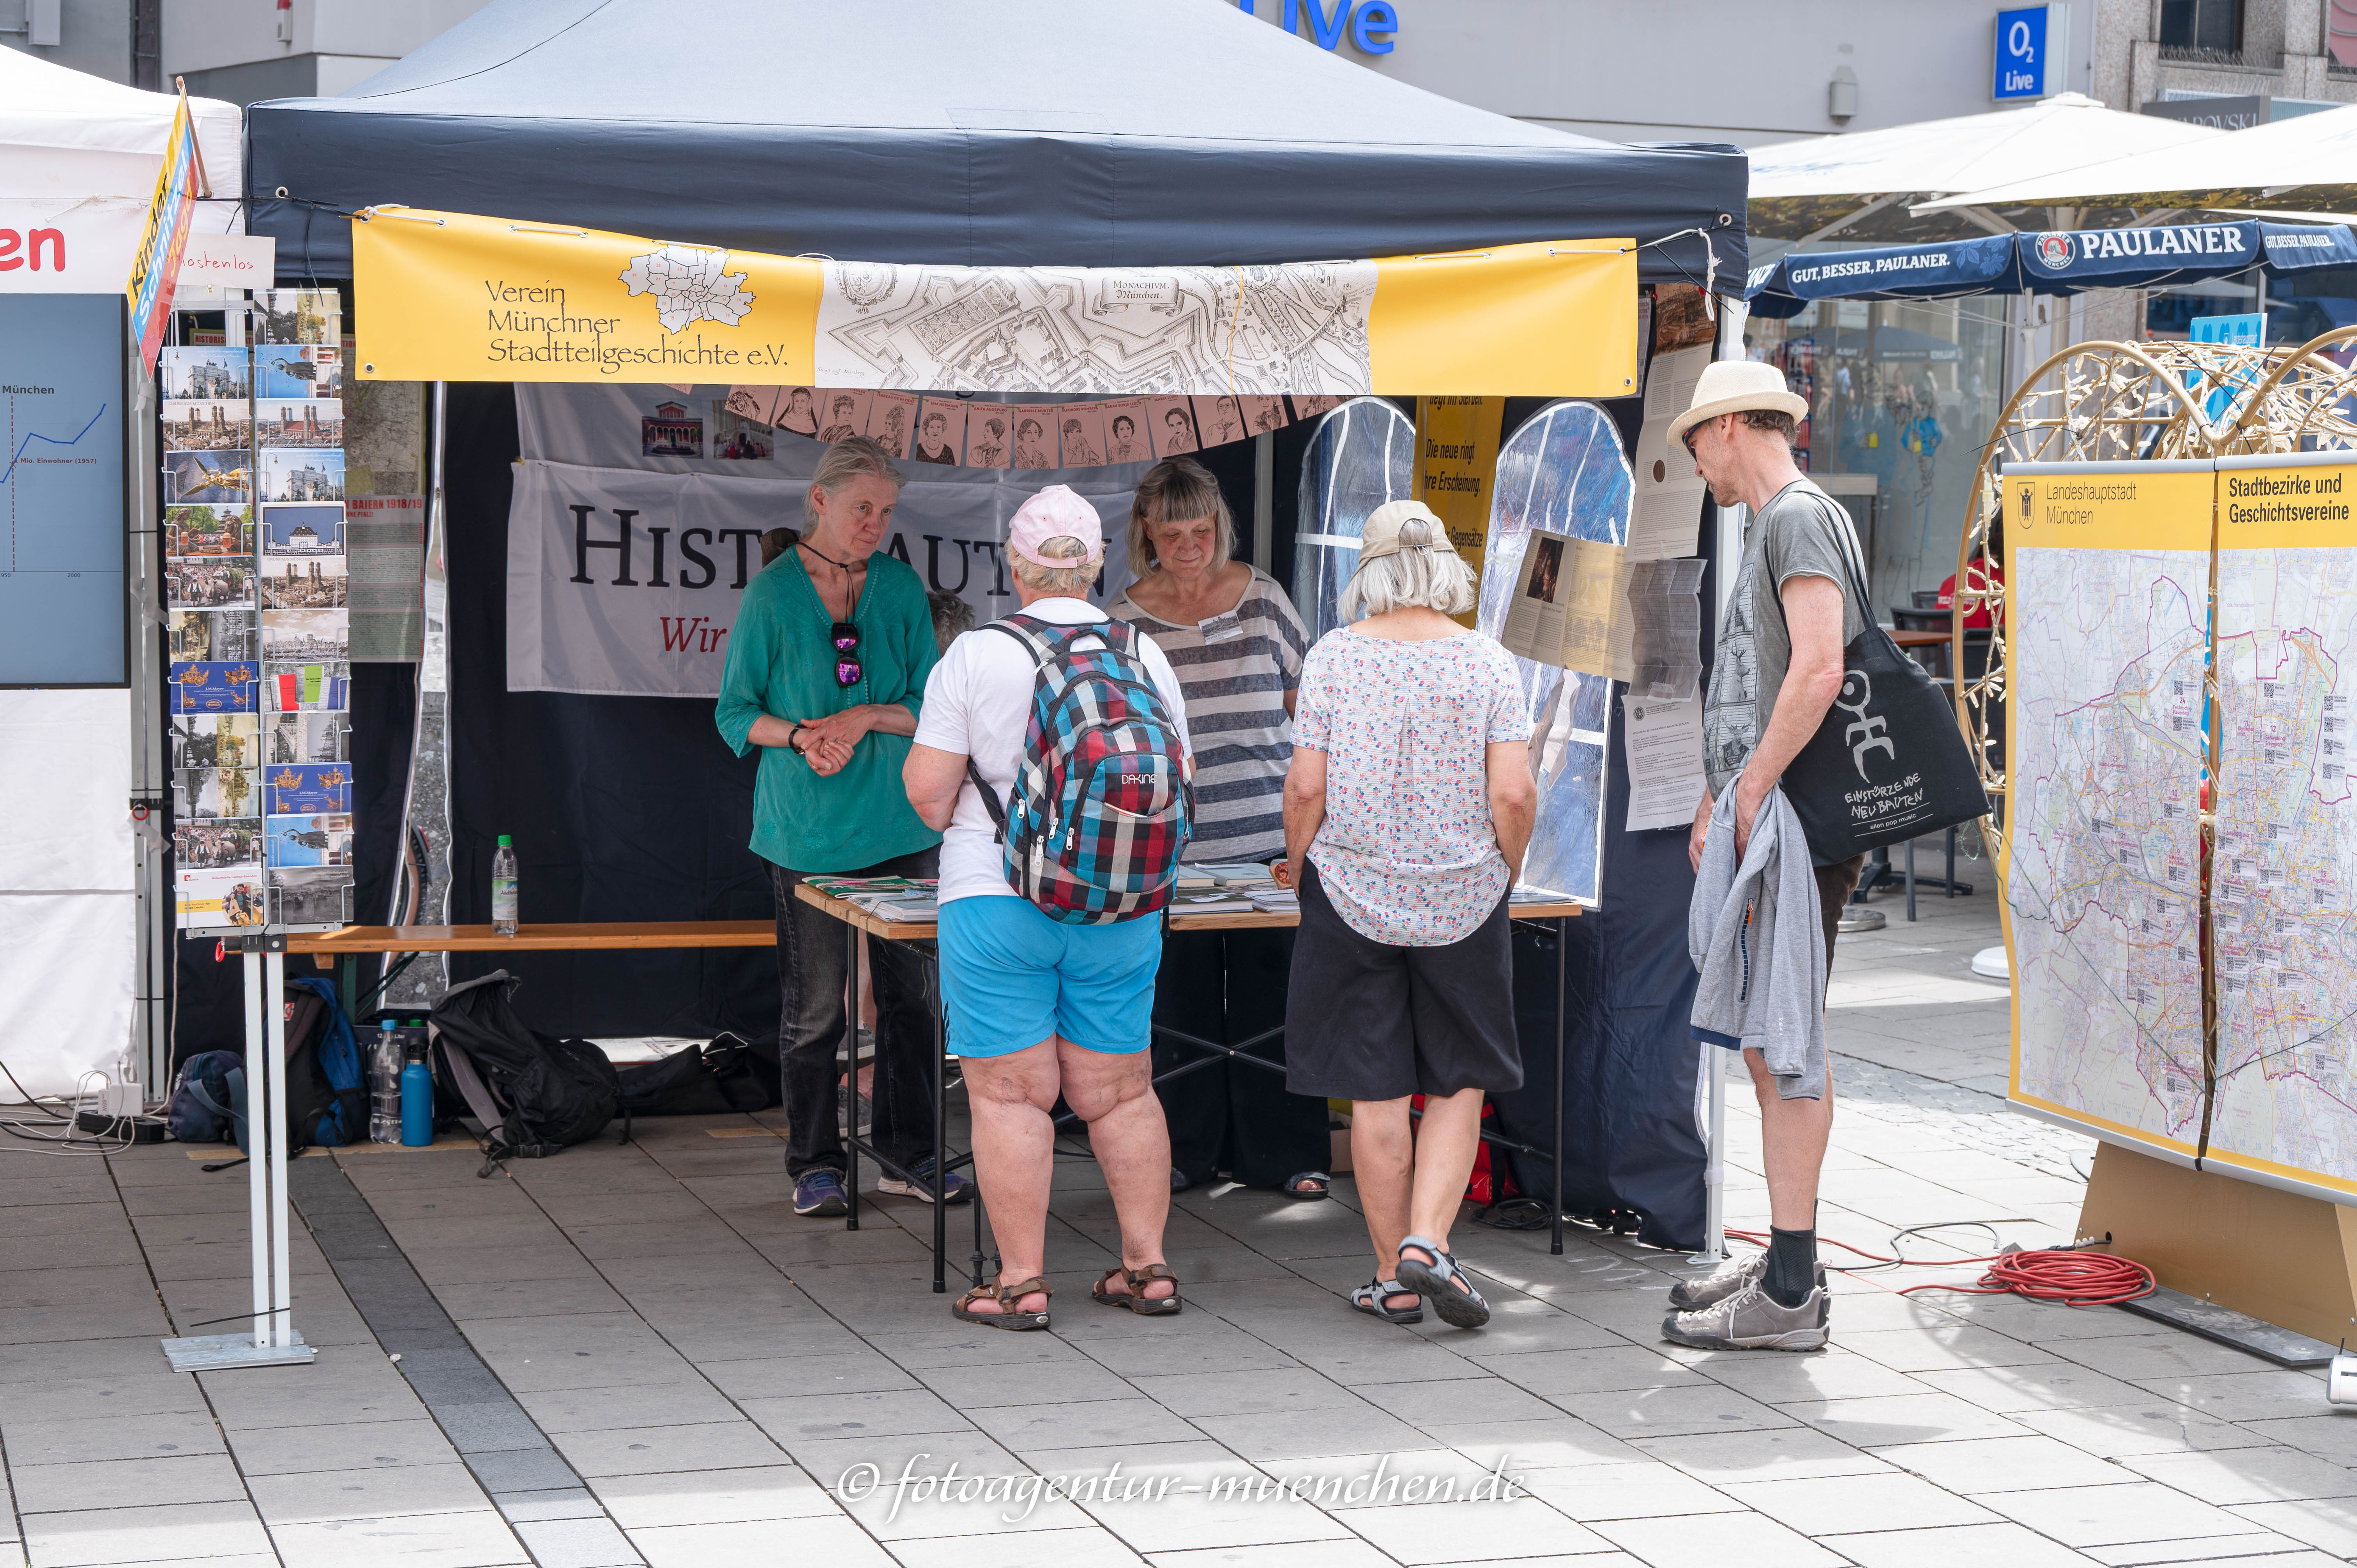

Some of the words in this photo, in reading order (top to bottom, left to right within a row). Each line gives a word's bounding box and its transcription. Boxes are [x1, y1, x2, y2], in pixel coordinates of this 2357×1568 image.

[2005, 70, 2034, 92] Live
[2179, 113, 2257, 131] ROVSKI
[132, 172, 169, 300] Kinder
[140, 148, 189, 327] Schnitzel
[170, 176, 192, 278] Jagd
[2080, 226, 2246, 260] PAULANER
[182, 251, 254, 270] ostenlos
[1792, 268, 1820, 284] GUT,
[1822, 260, 1874, 280] BESSER,
[1876, 253, 1950, 272] PAULANER.
[485, 279, 565, 305] Verein
[1113, 281, 1169, 289] MONACHIVM.
[1116, 289, 1163, 300] München.
[488, 302, 621, 334] Münchner
[195, 335, 226, 344] HISTORIS
[488, 332, 740, 374] Stadtteilgeschichte
[747, 344, 788, 366] e.V.
[2, 385, 55, 395] München
[261, 440, 341, 449] stdtgeschichte-muenchende
[1426, 438, 1438, 458] Die
[1440, 445, 1458, 459] neue
[1459, 440, 1475, 465] ringt
[1424, 471, 1437, 490] hre
[1438, 471, 1481, 498] Erscheinung.
[2046, 480, 2136, 504] Landeshauptstadt
[2229, 475, 2311, 498] Stadtbezirke
[2315, 472, 2342, 494] und
[352, 499, 384, 509] BAIERN
[386, 498, 422, 509] 1918/19
[2046, 505, 2093, 525] München
[2229, 499, 2350, 524] Geschichtsvereine
[1451, 526, 1483, 552] Gegensätze
[660, 616, 727, 653] Wir
[1885, 820, 1897, 828] pop
[1899, 812, 1916, 823] music
